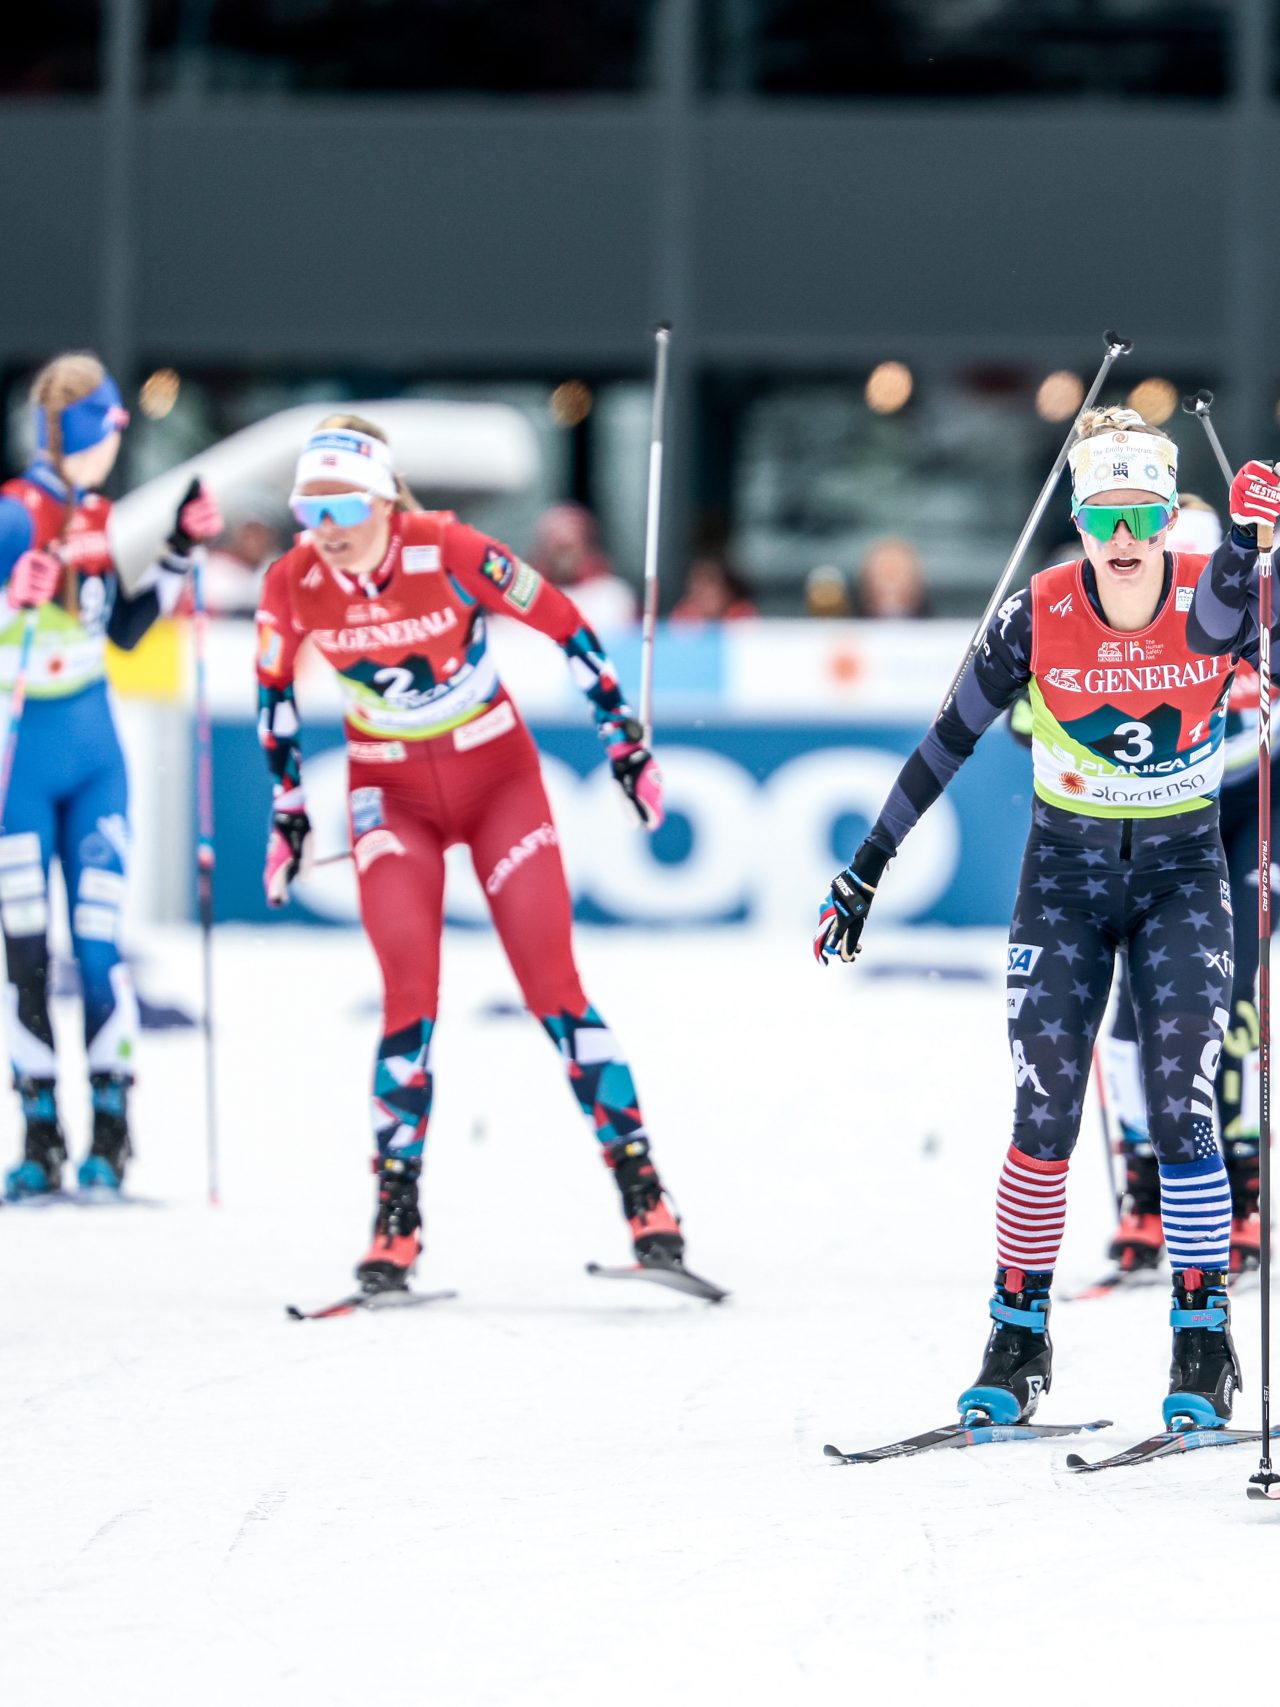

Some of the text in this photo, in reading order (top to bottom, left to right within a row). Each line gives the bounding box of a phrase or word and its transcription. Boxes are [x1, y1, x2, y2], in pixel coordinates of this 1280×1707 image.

[1249, 482, 1280, 501] HESTRA
[373, 667, 415, 699] 2
[1084, 656, 1220, 694] GENERALI
[1259, 623, 1271, 755] SWIX
[1113, 721, 1154, 763] 3
[1188, 720, 1205, 743] 1
[1078, 757, 1188, 778] PLANICA
